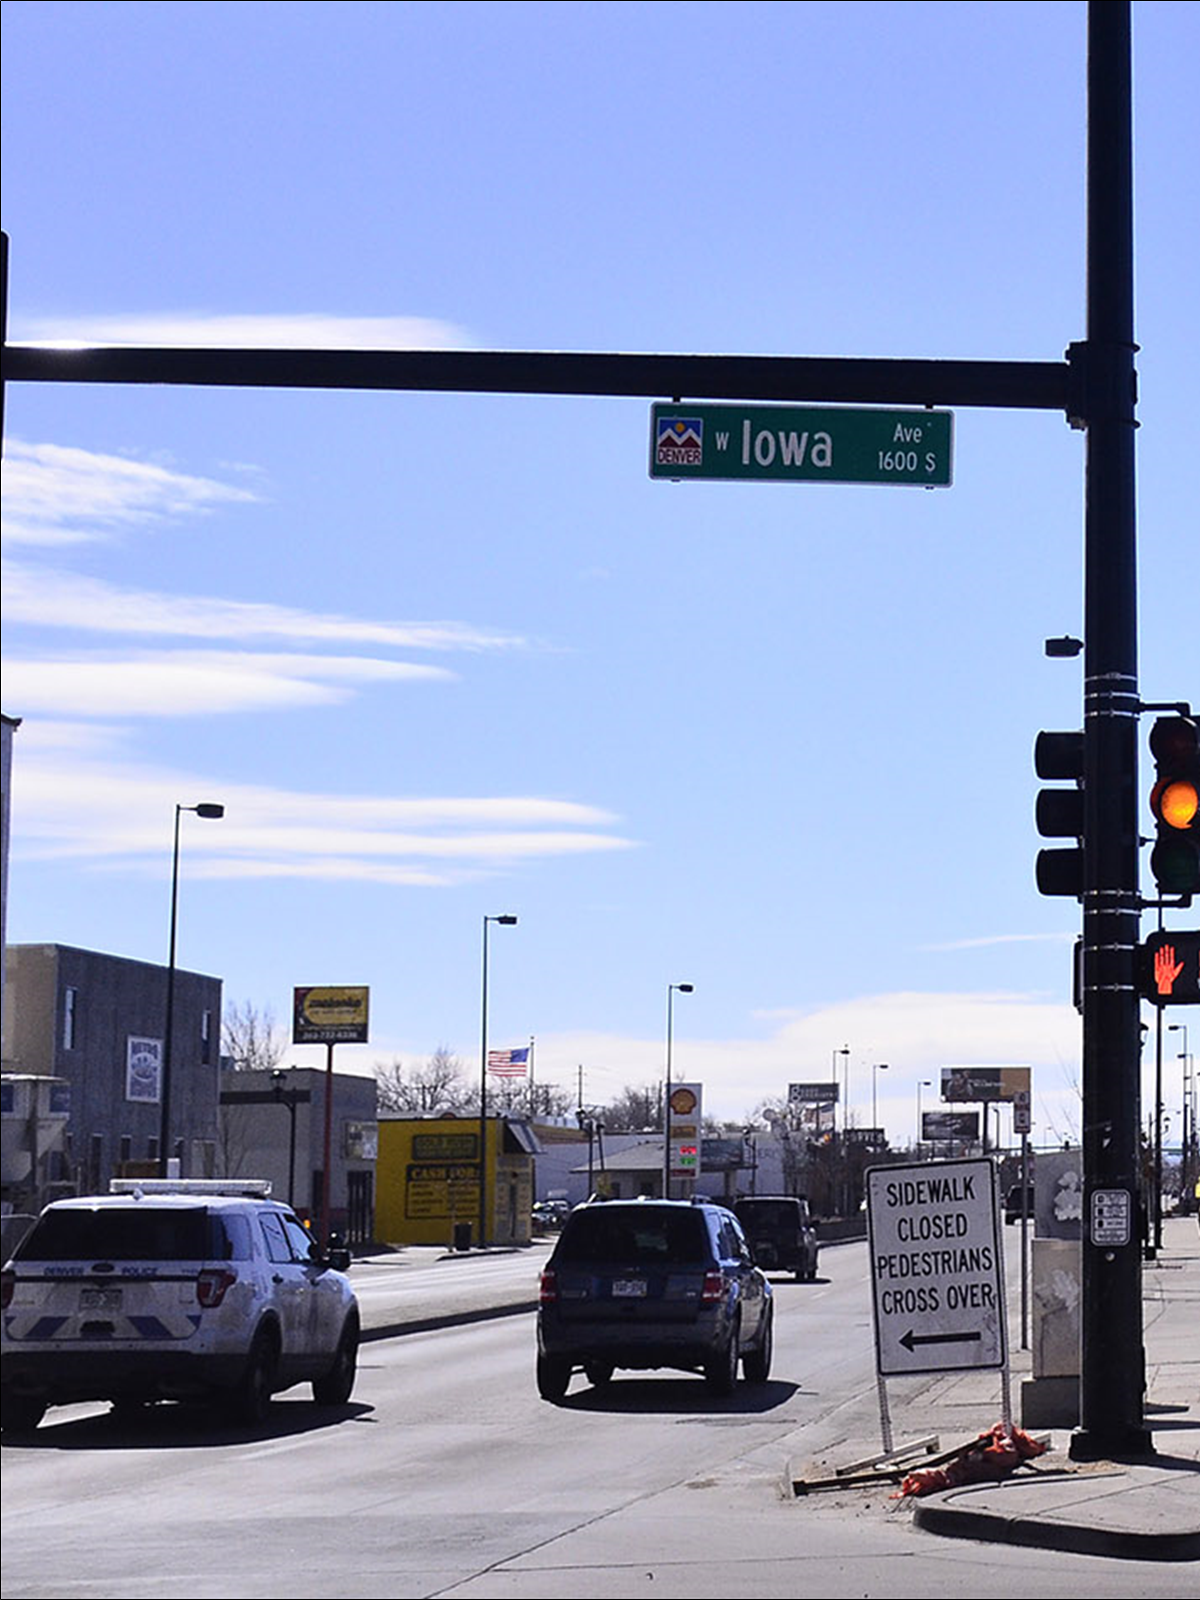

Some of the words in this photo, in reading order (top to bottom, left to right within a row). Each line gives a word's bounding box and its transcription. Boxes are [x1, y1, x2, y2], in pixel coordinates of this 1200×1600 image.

[715, 431, 729, 450] W
[742, 419, 832, 467] Iowa
[893, 422, 922, 443] Ave
[657, 448, 701, 464] DENVER
[878, 451, 917, 471] 1600
[925, 453, 936, 473] S
[886, 1176, 975, 1207] SIDEWALK
[898, 1213, 968, 1242] CLOSED
[878, 1247, 993, 1279] PEDESTRIANS
[882, 1287, 939, 1315] CROSS
[947, 1283, 995, 1310] OVER
